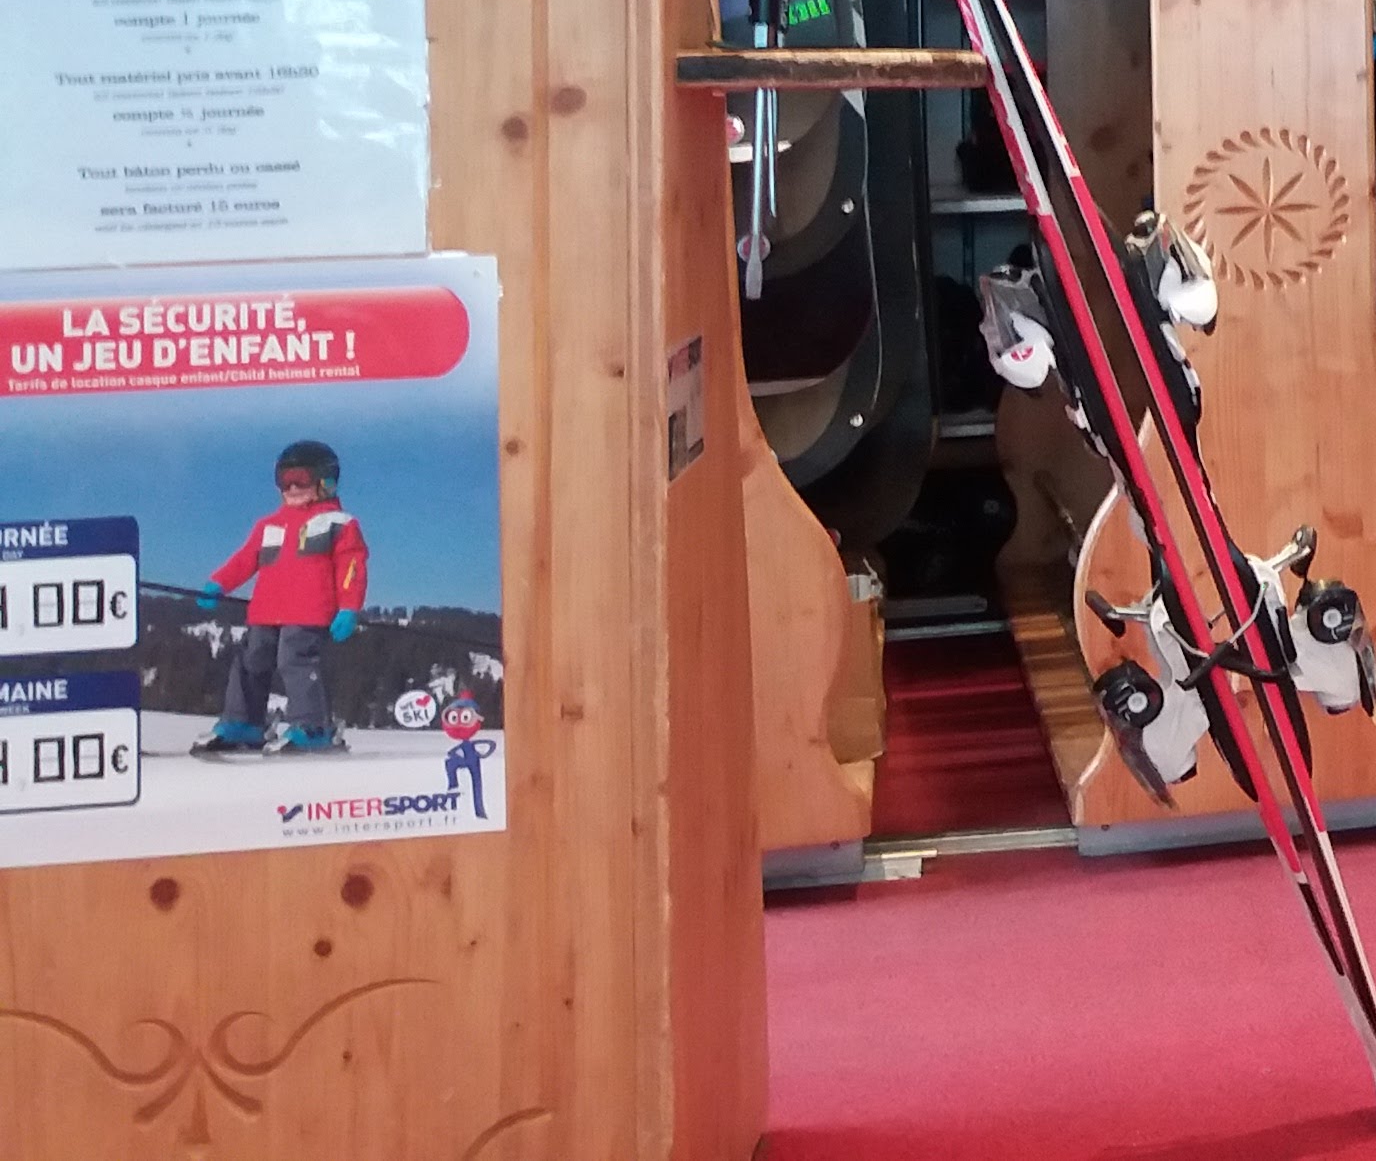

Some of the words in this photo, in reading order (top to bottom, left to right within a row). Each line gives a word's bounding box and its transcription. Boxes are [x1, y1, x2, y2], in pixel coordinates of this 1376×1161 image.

[177, 72, 209, 85] pris
[215, 69, 260, 81] avant
[112, 108, 174, 122] compte
[200, 104, 265, 121] journée
[77, 166, 118, 180] Tout
[177, 162, 224, 178] perdu
[143, 201, 202, 215] facturé
[234, 200, 280, 211] euros
[62, 308, 110, 337] LA
[119, 293, 306, 336] SÉCURITÉ,
[11, 343, 63, 373] UN
[72, 339, 143, 371] JEU
[153, 332, 333, 368] D'ENFANT
[8, 377, 47, 392] Tarifs
[51, 377, 68, 390] de
[71, 375, 126, 389] location
[129, 375, 177, 389] casque
[268, 367, 316, 380] helmet
[319, 364, 360, 378] rental
[403, 710, 429, 723] SKI
[308, 792, 460, 821] INTERSPORT
